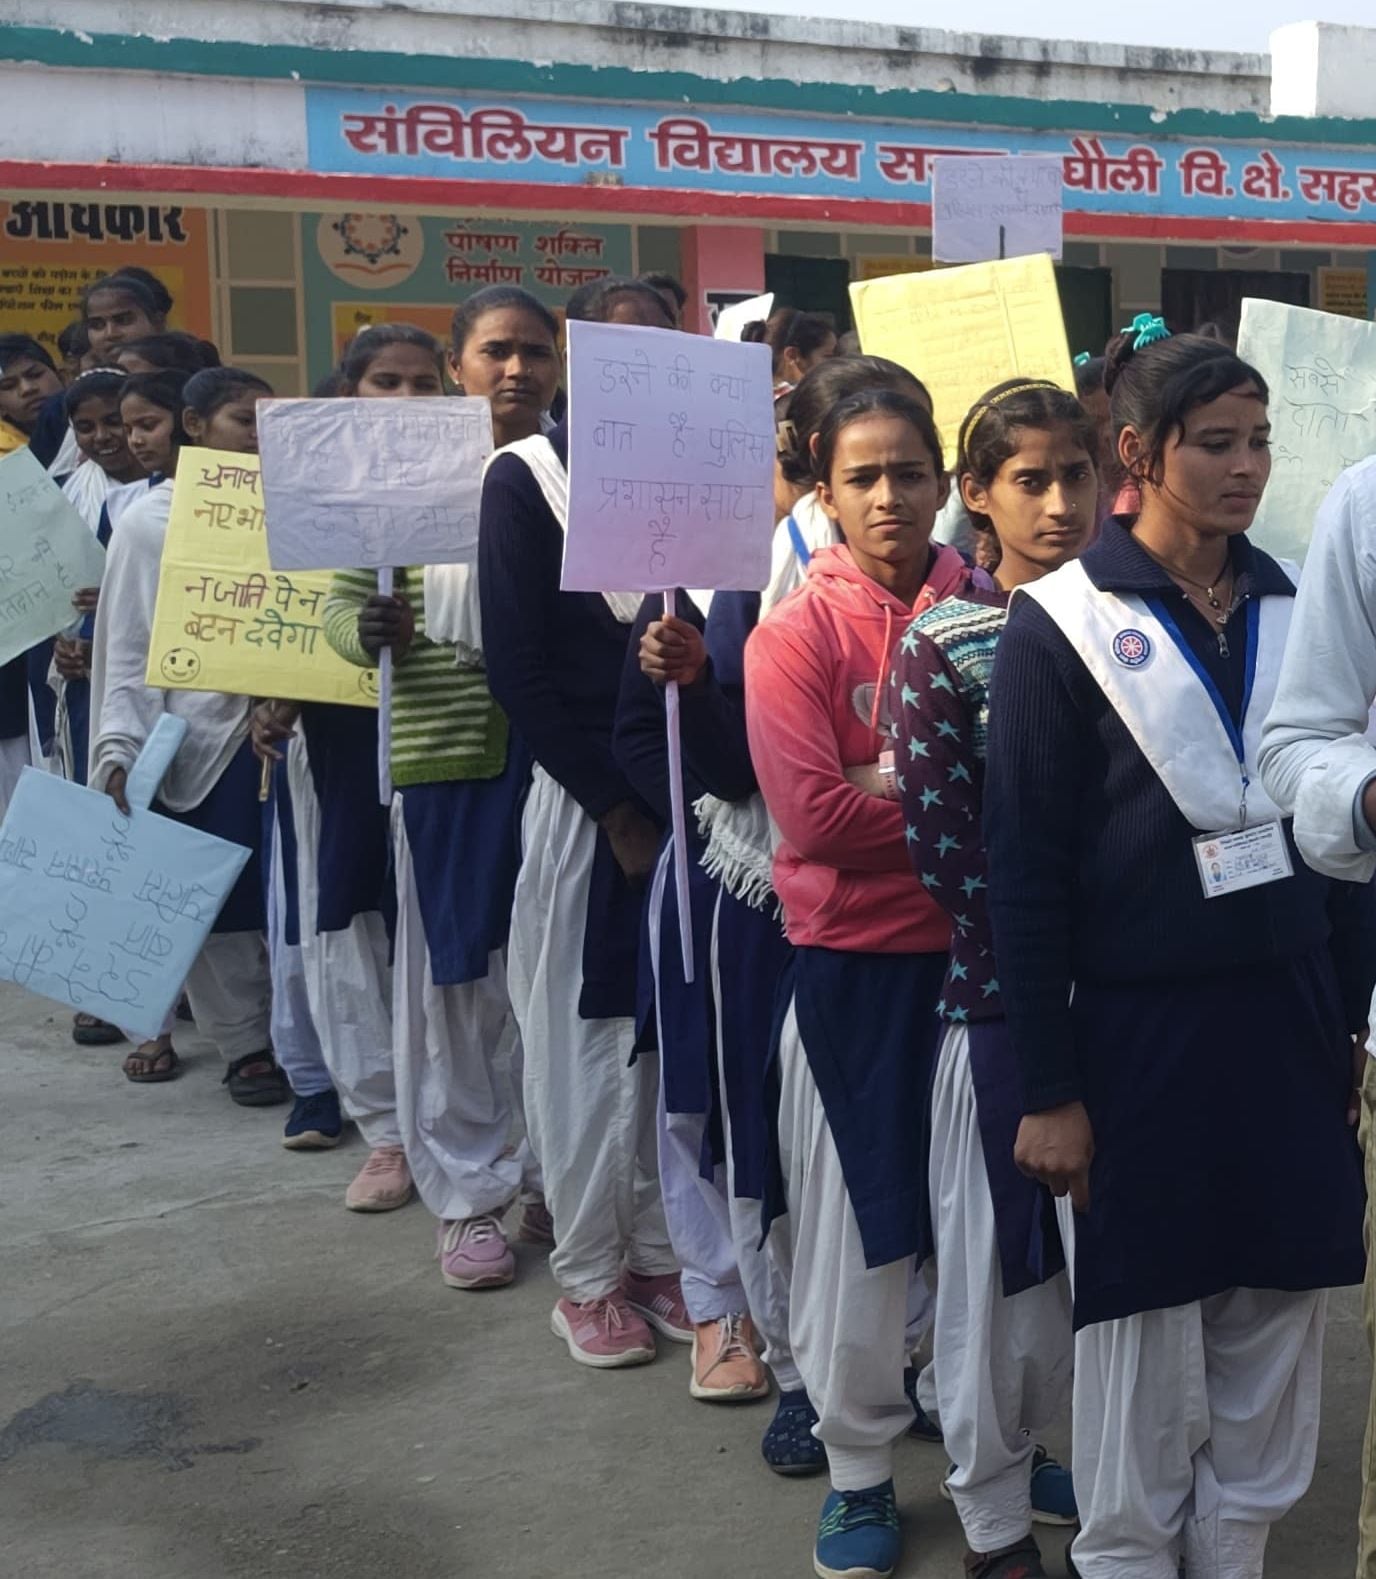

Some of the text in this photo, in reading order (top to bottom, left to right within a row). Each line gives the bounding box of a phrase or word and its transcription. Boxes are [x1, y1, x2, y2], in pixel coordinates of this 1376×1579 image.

[343, 105, 629, 166] संविलियन
[649, 120, 862, 180] विद्यालय
[1060, 137, 1163, 193] घौली
[1179, 150, 1234, 196] वि.
[1243, 151, 1290, 198] क्षे.
[446, 222, 604, 256] पोषण शक्ति
[446, 255, 523, 285] निर्माण
[704, 419, 769, 468] पुलिस
[196, 463, 262, 495] चुनाव
[184, 611, 245, 645] बटन
